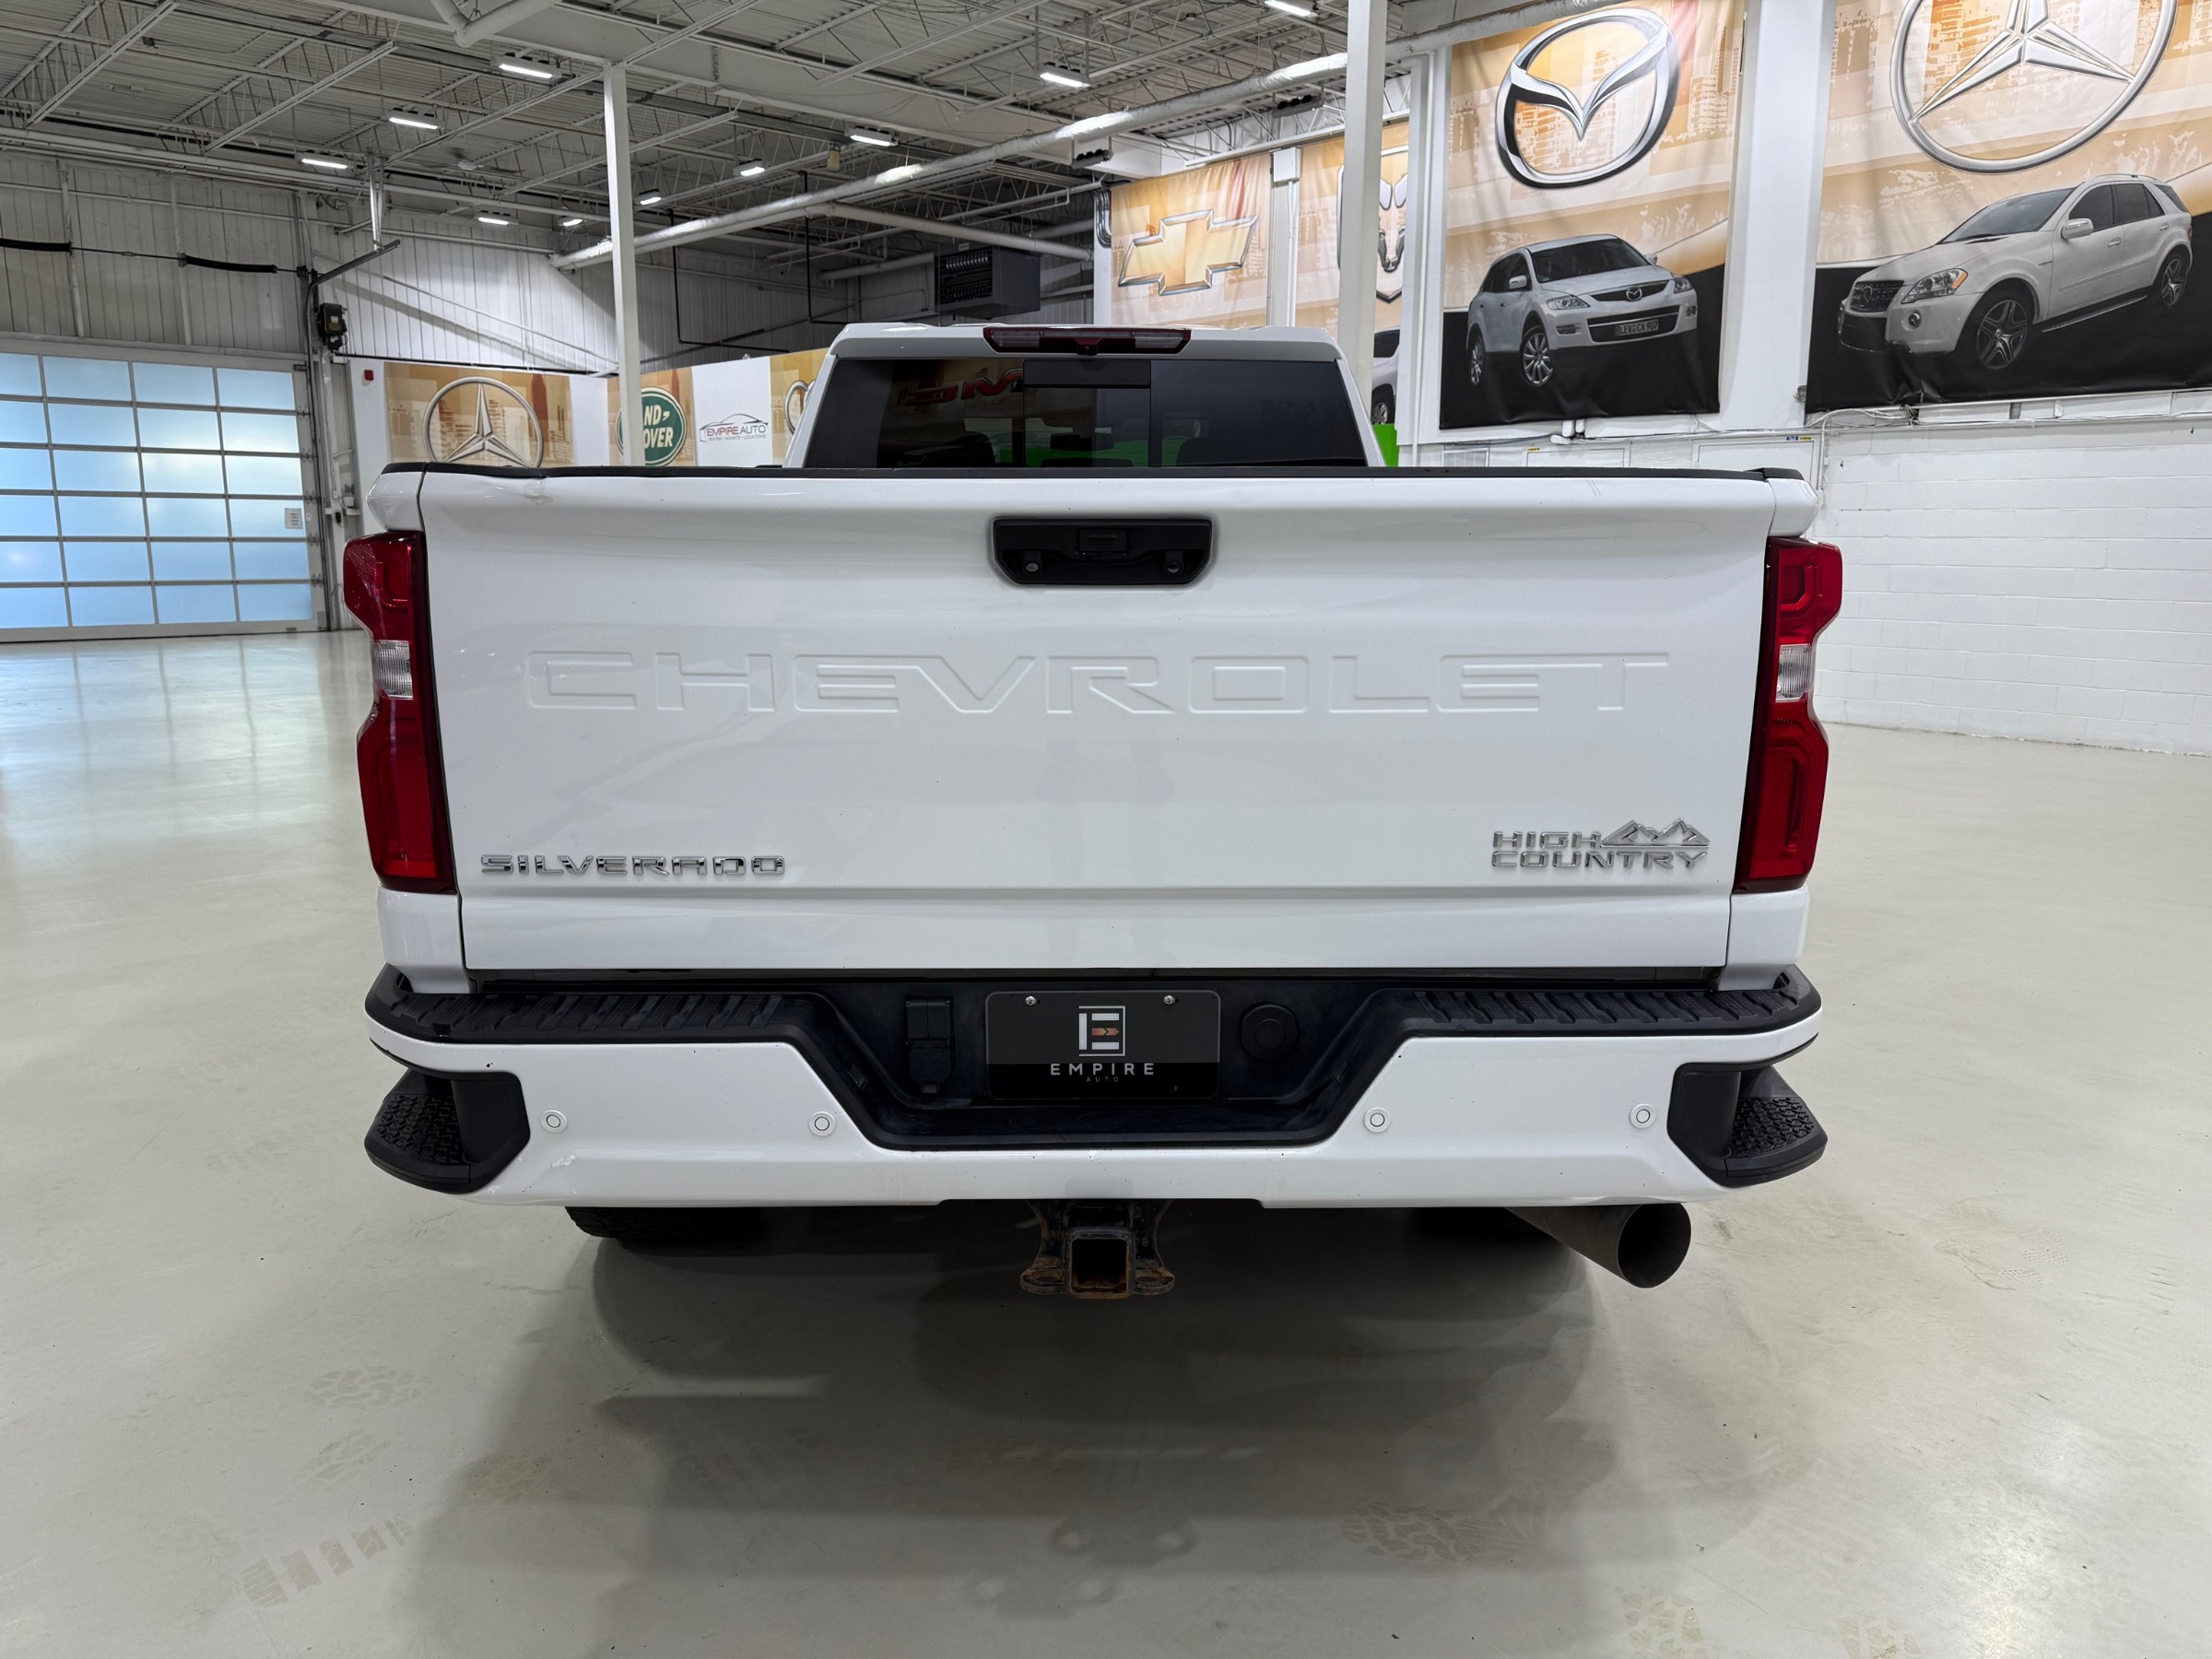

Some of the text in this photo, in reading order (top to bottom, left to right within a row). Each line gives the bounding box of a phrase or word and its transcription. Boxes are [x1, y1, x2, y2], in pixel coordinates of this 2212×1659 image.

[1619, 324, 1632, 335] LEV
[1637, 323, 1645, 333] CX
[643, 427, 674, 449] OVER
[707, 425, 766, 437] EMPIRE AUTO
[526, 651, 1669, 715] CHEVROLET
[1493, 830, 1602, 849] HIGH
[481, 854, 785, 876] SILVERADO
[1491, 851, 1709, 869] COUNTRY
[1051, 1063, 1155, 1076] EMPIRE
